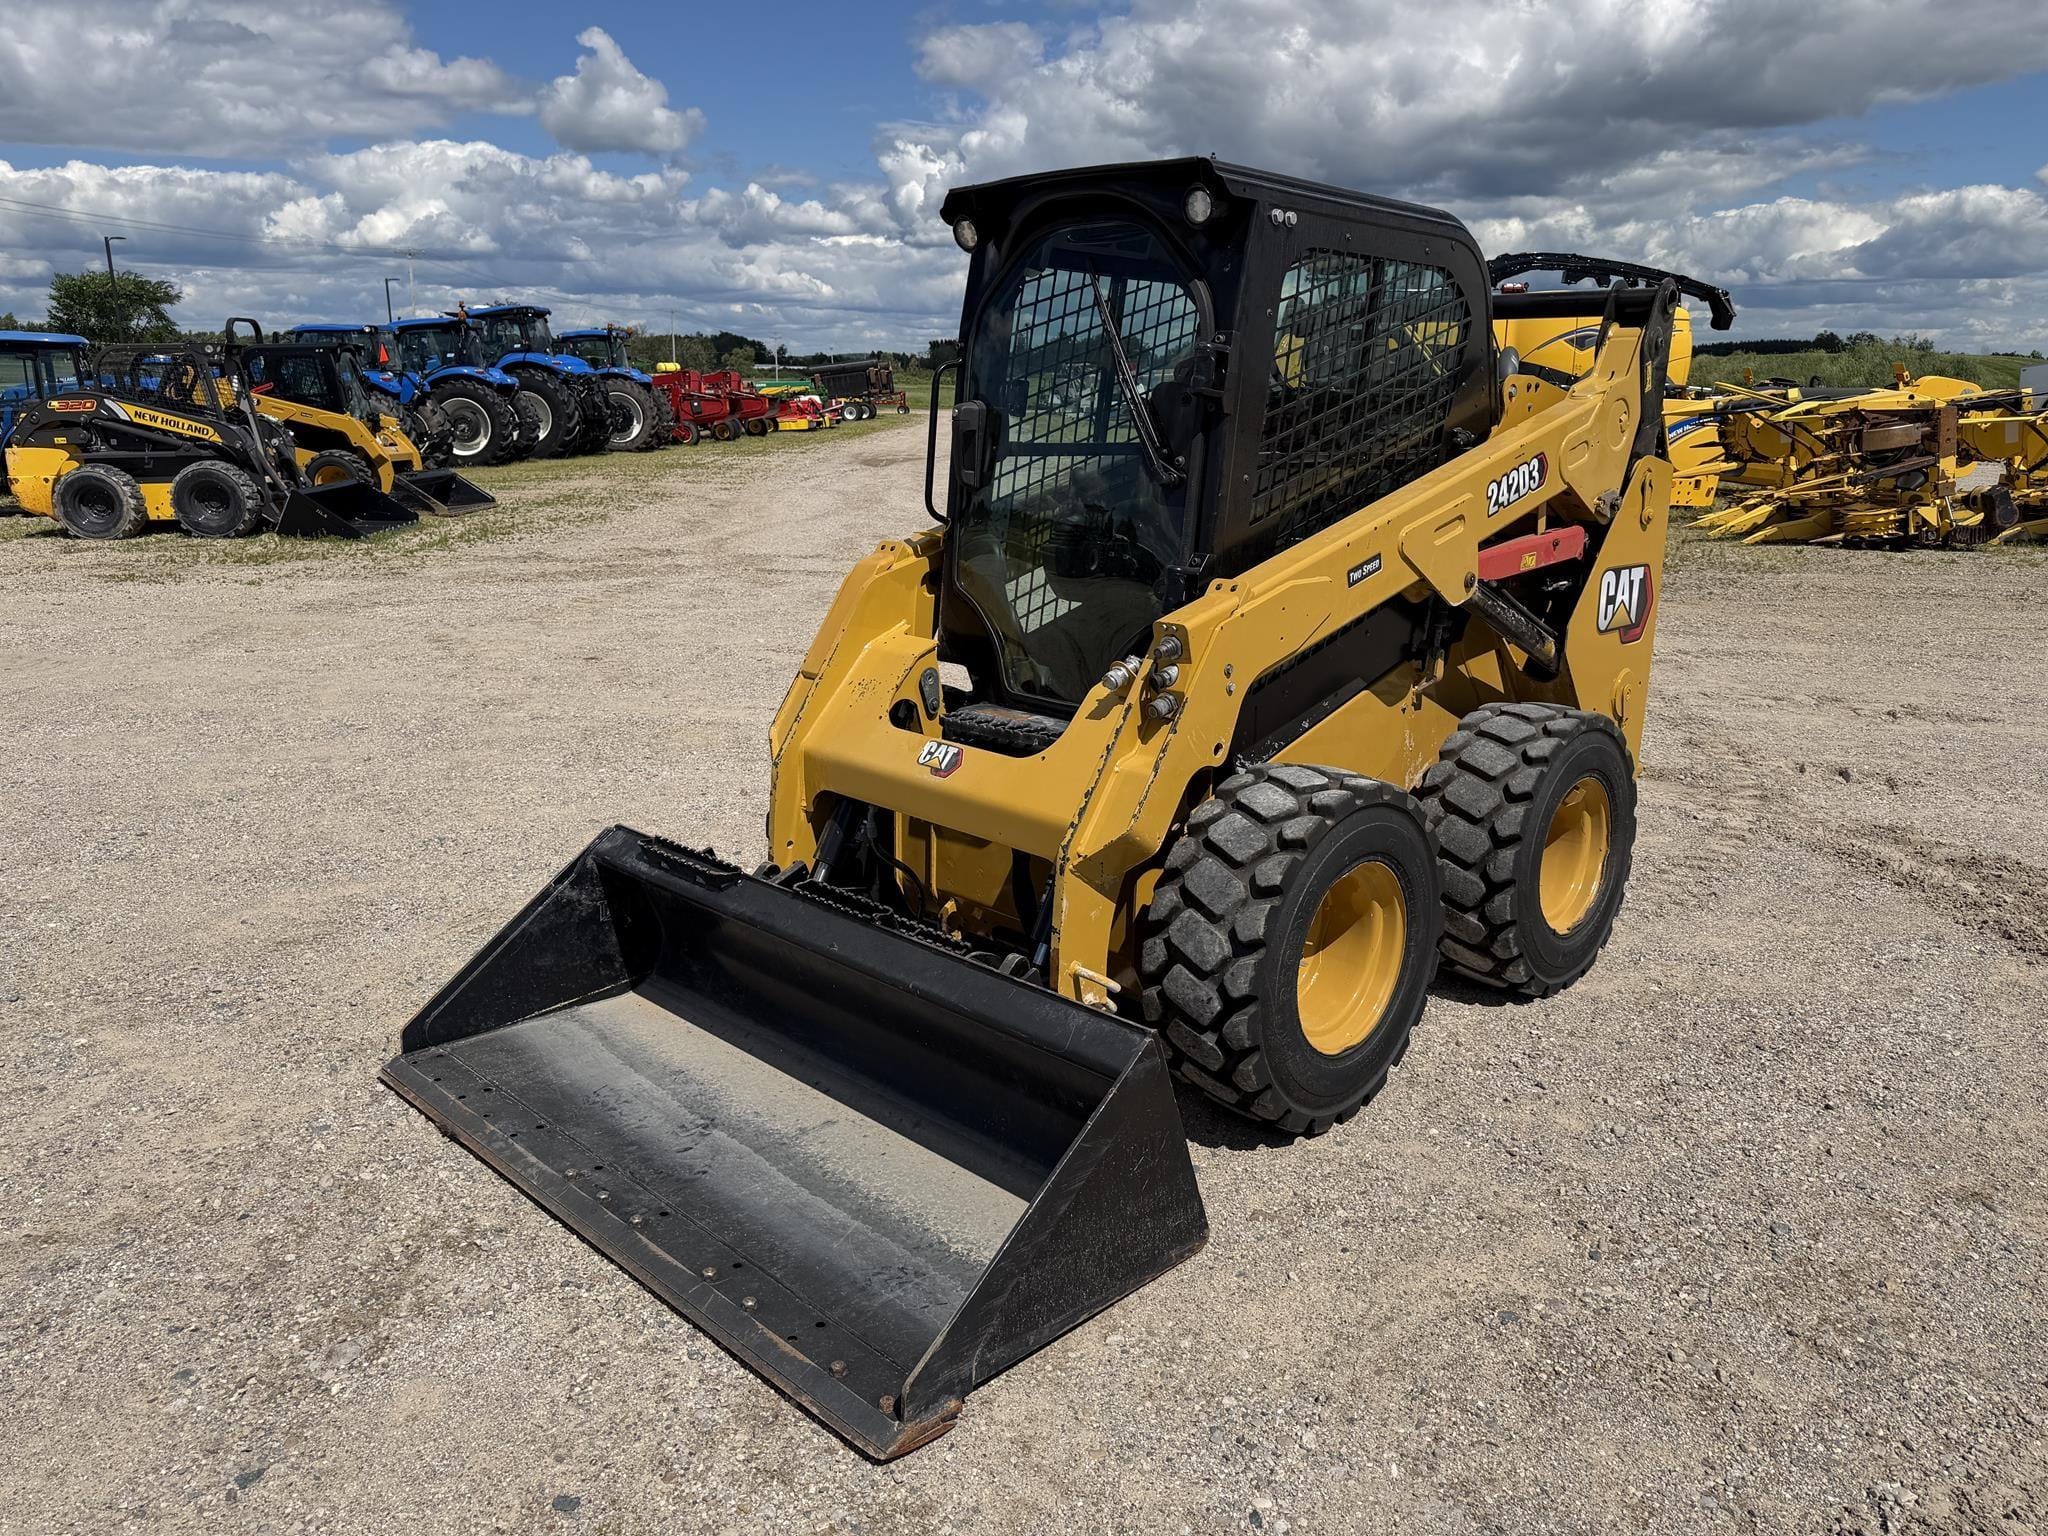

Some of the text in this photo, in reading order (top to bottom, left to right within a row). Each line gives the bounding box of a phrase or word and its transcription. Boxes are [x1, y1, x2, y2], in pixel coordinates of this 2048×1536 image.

[47, 400, 97, 412] L320
[134, 410, 210, 436] NEW HOLLAND
[1668, 427, 1684, 439] NEW
[1486, 458, 1540, 517] 242D3
[1598, 566, 1645, 632] CAT
[918, 740, 959, 770] CAT
